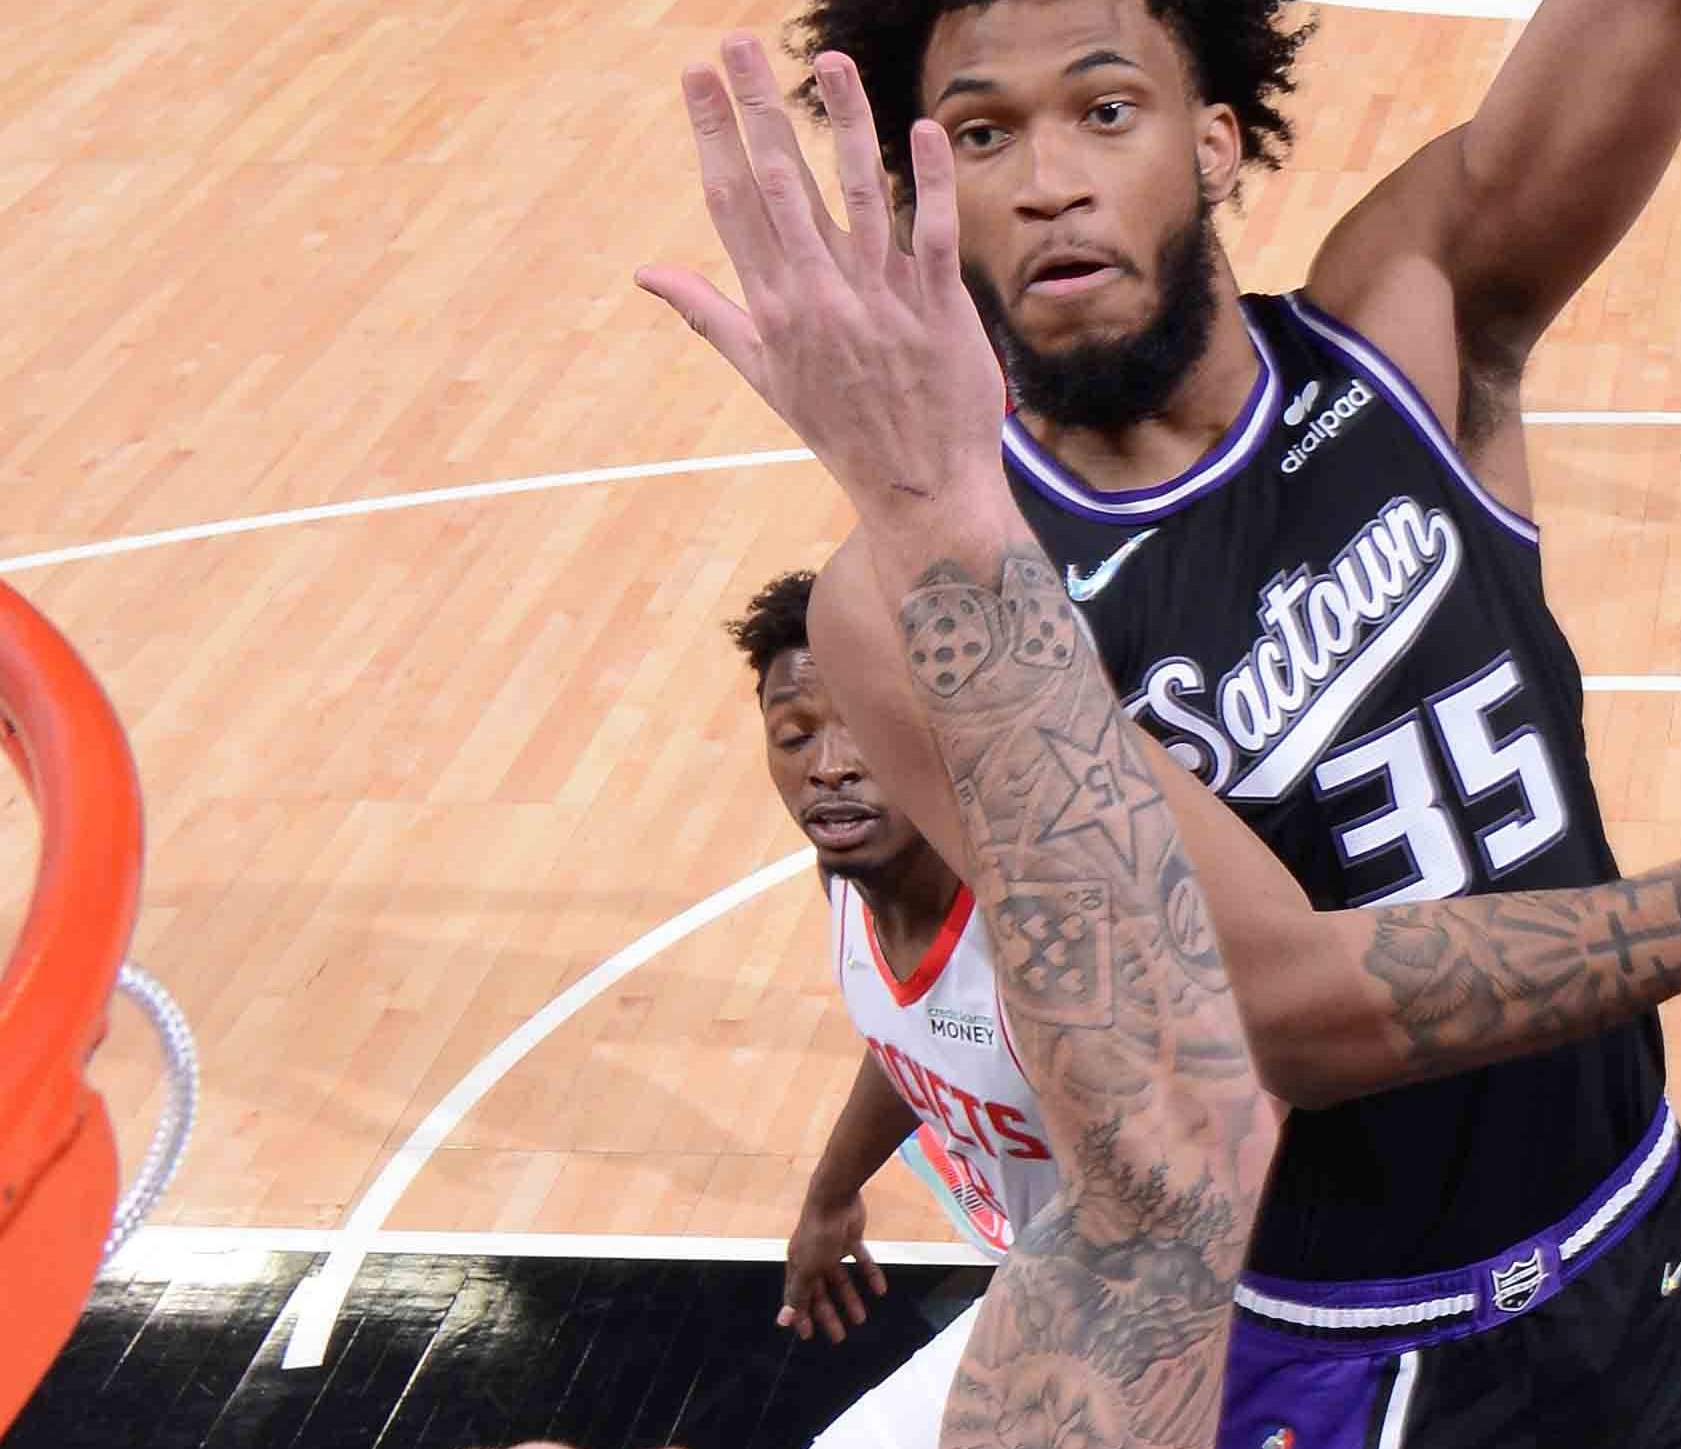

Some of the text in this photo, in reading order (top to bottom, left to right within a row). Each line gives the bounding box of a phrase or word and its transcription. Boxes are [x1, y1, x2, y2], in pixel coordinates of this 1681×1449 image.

[1280, 379, 1373, 475] dialpad
[1120, 496, 1459, 803] Sactown
[1317, 652, 1567, 910] 35
[930, 1019, 995, 1046] MONEY
